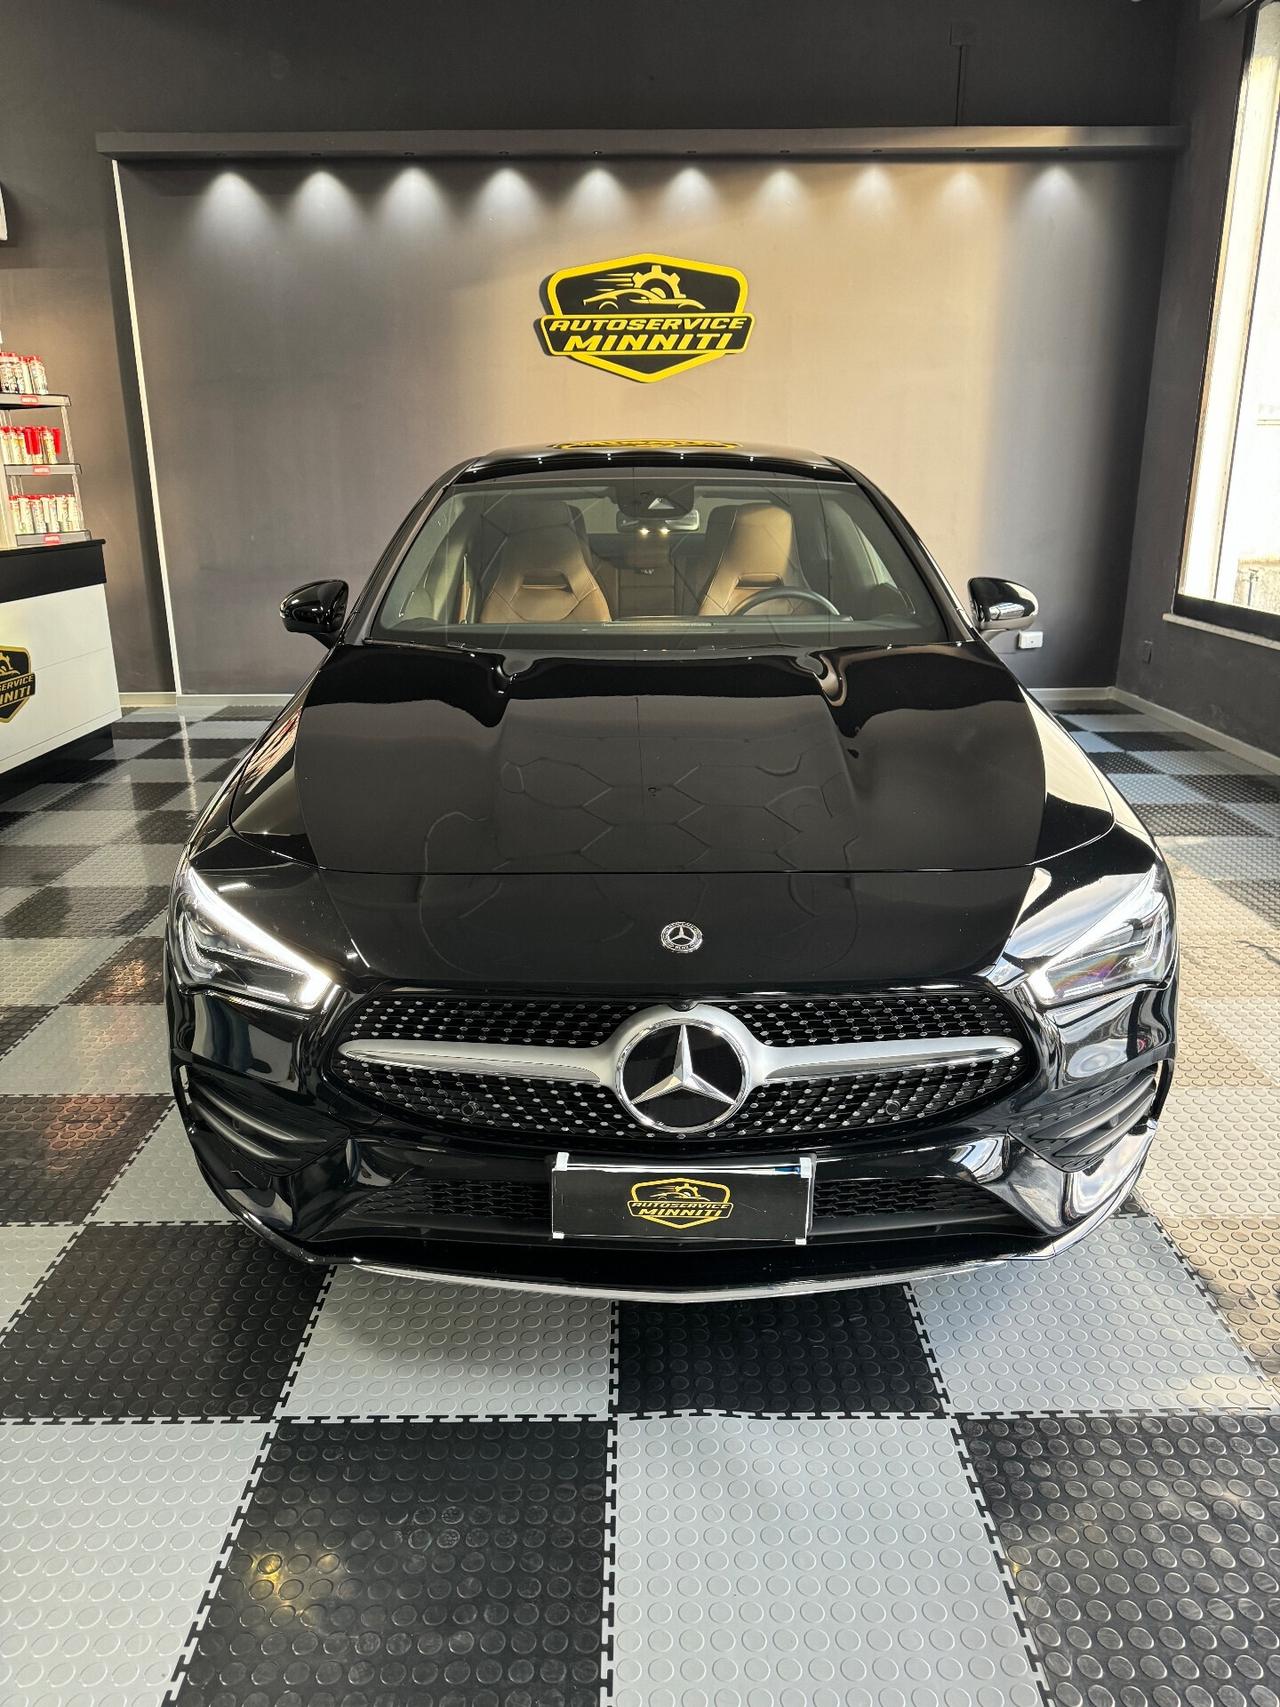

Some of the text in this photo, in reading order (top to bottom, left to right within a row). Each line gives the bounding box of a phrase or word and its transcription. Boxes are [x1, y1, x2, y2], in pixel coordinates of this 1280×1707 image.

[549, 317, 747, 331] AUTOSERVICE
[563, 333, 733, 351] MINNITI
[0, 675, 34, 690] ERVICE
[638, 1208, 722, 1216] MINNITI
